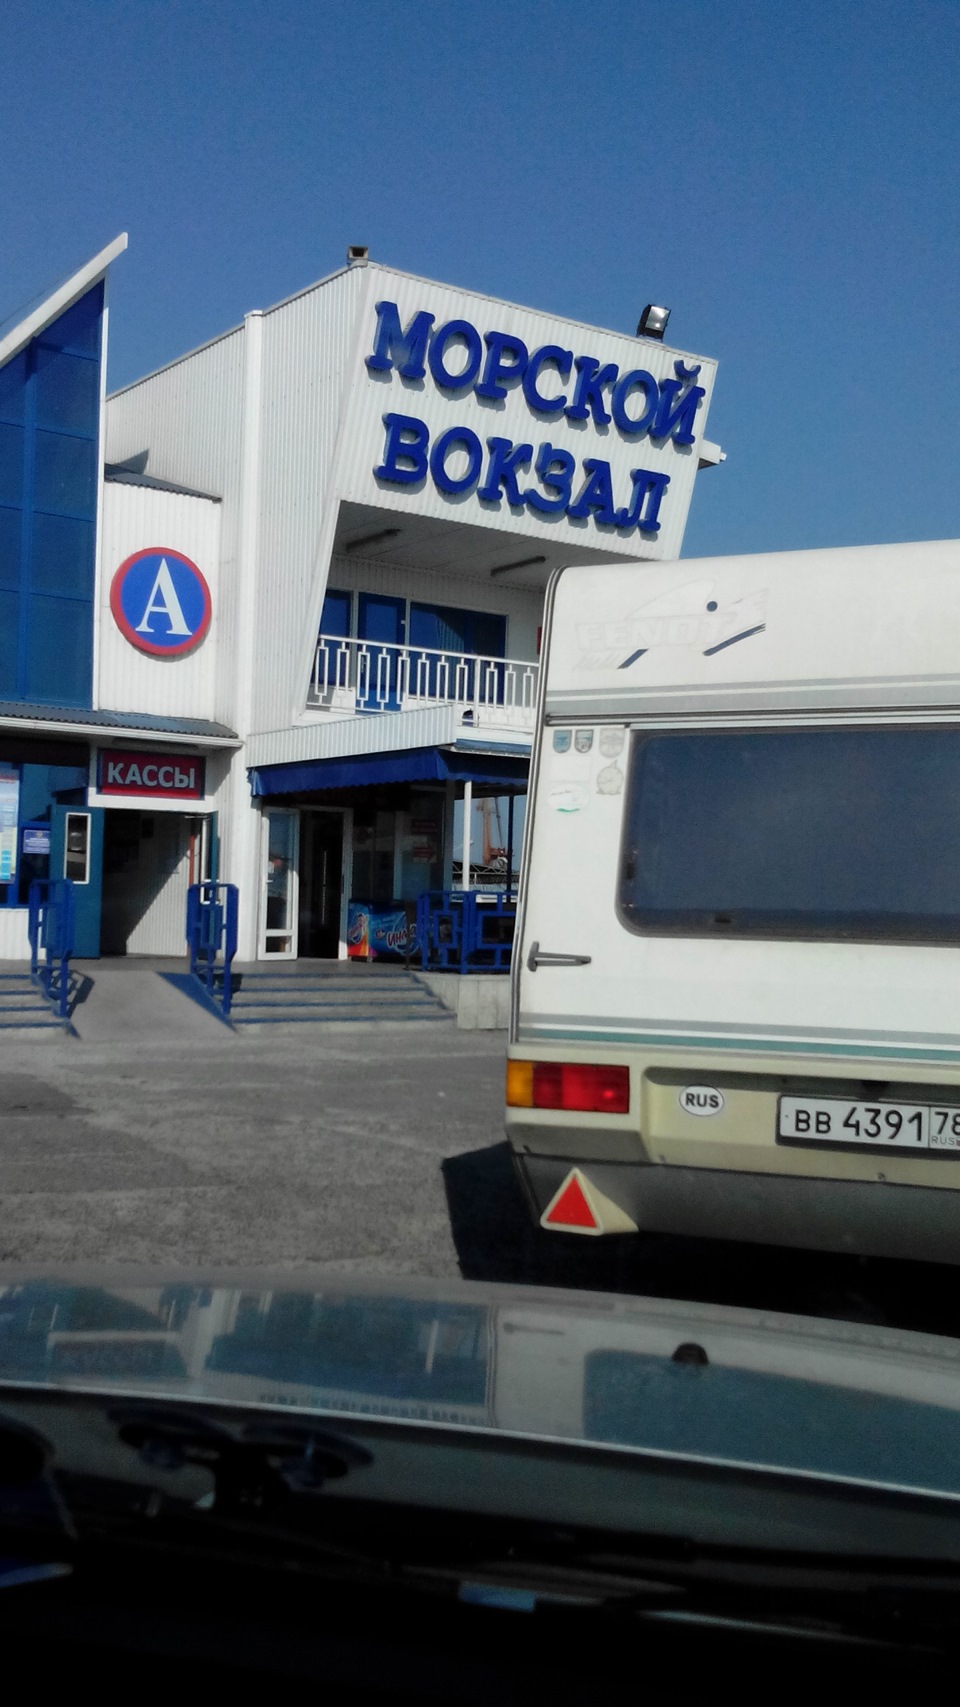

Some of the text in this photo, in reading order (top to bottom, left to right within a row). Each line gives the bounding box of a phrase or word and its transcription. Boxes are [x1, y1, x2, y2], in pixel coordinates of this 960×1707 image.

[364, 300, 706, 446] МОРСКОЙ
[372, 412, 671, 532] ВОКЗАЛ
[135, 558, 193, 636] А
[107, 761, 195, 789] КАССЫ
[685, 1092, 720, 1109] RUS
[794, 1106, 960, 1142] ВВ 4391 78
[931, 1135, 955, 1146] RUS
